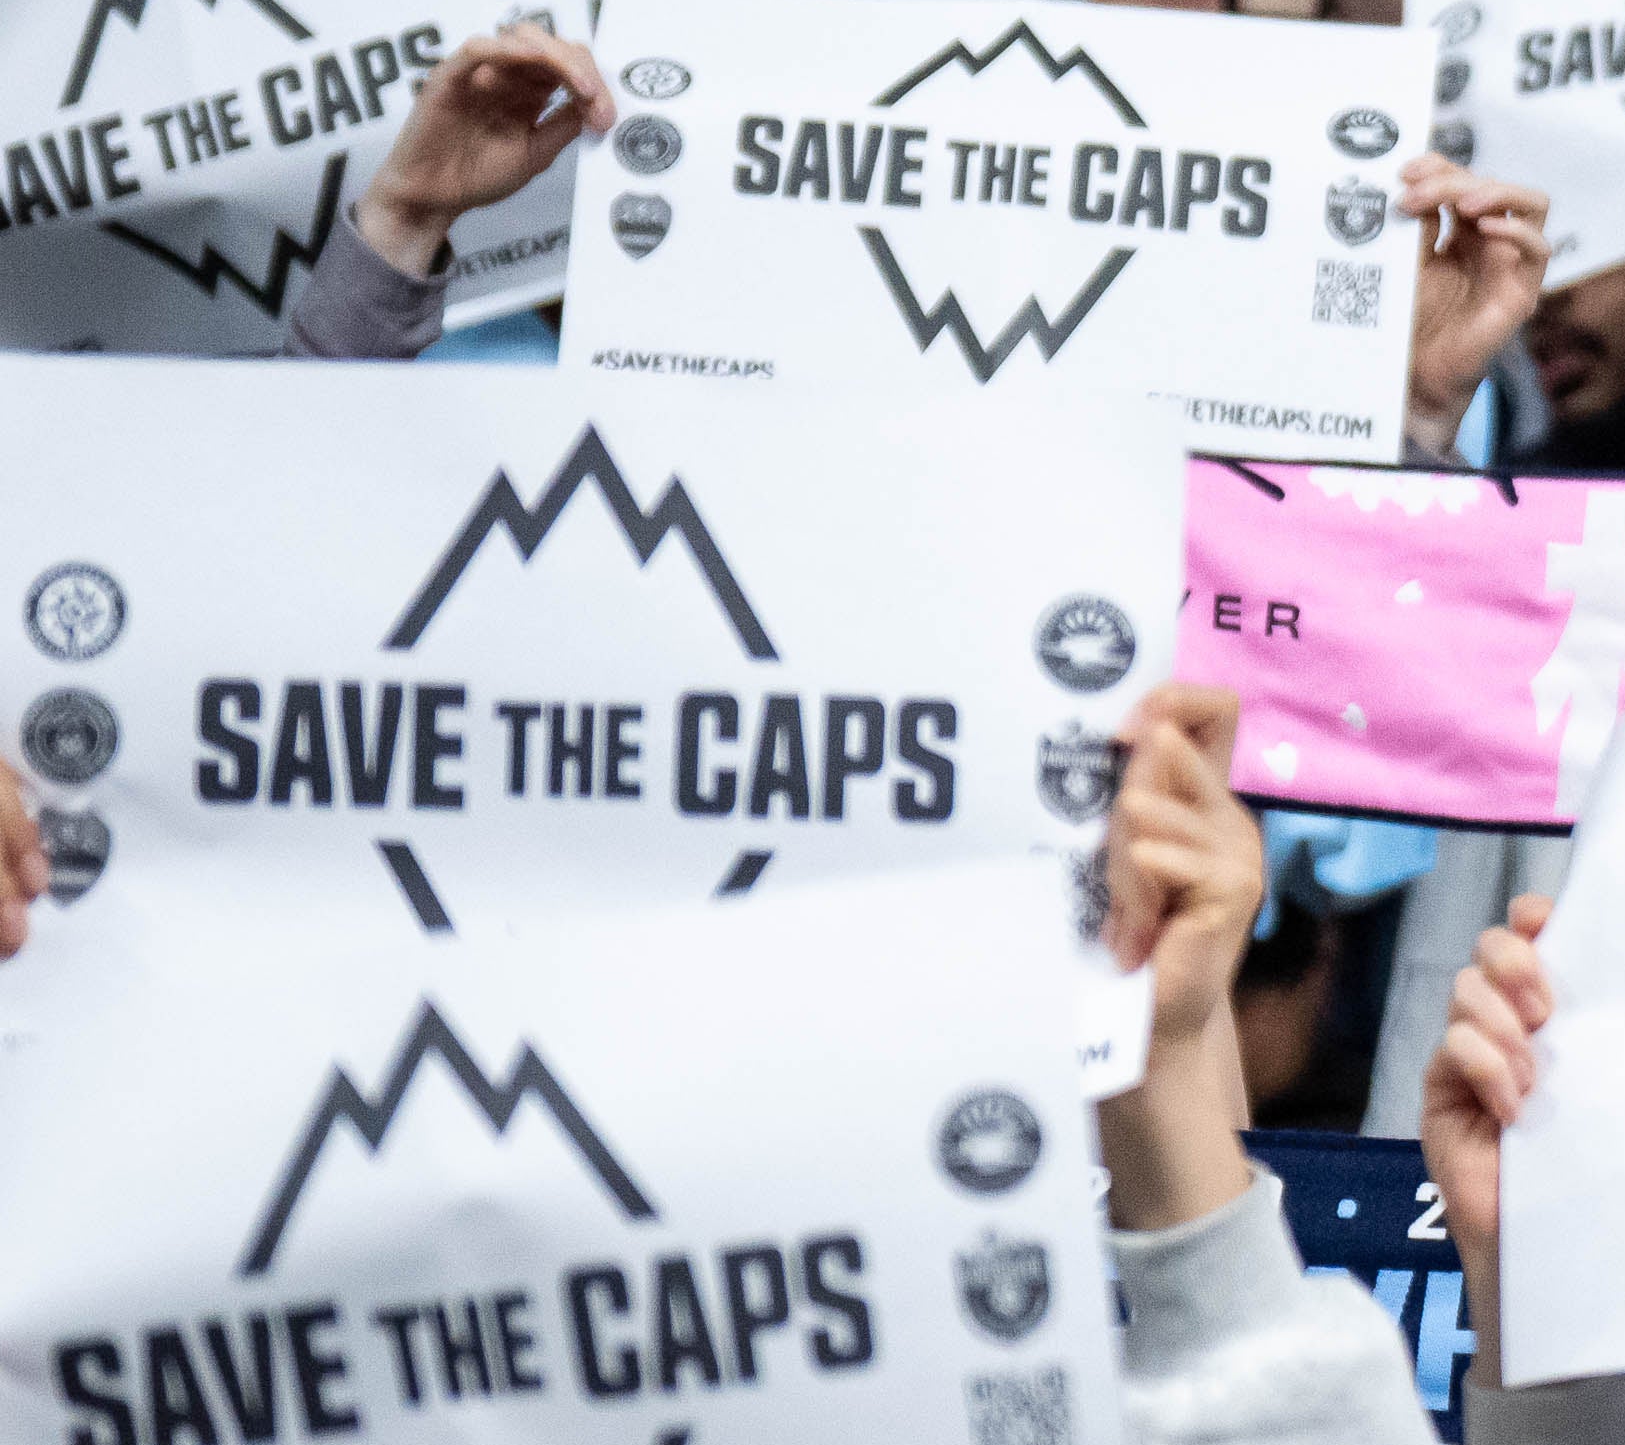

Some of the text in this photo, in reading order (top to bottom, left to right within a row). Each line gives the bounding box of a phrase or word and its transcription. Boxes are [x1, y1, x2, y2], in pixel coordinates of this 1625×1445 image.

[0, 21, 444, 232] AVE THE CAPS
[733, 113, 1274, 240] SAVE THE CAPS
[591, 348, 776, 382] #SAVETHECAPS
[1147, 390, 1375, 441] ETHECAPS.COM
[197, 677, 960, 823] SAVE THE CAPS
[373, 1288, 546, 1408] THE
[562, 1228, 878, 1404] CAPS
